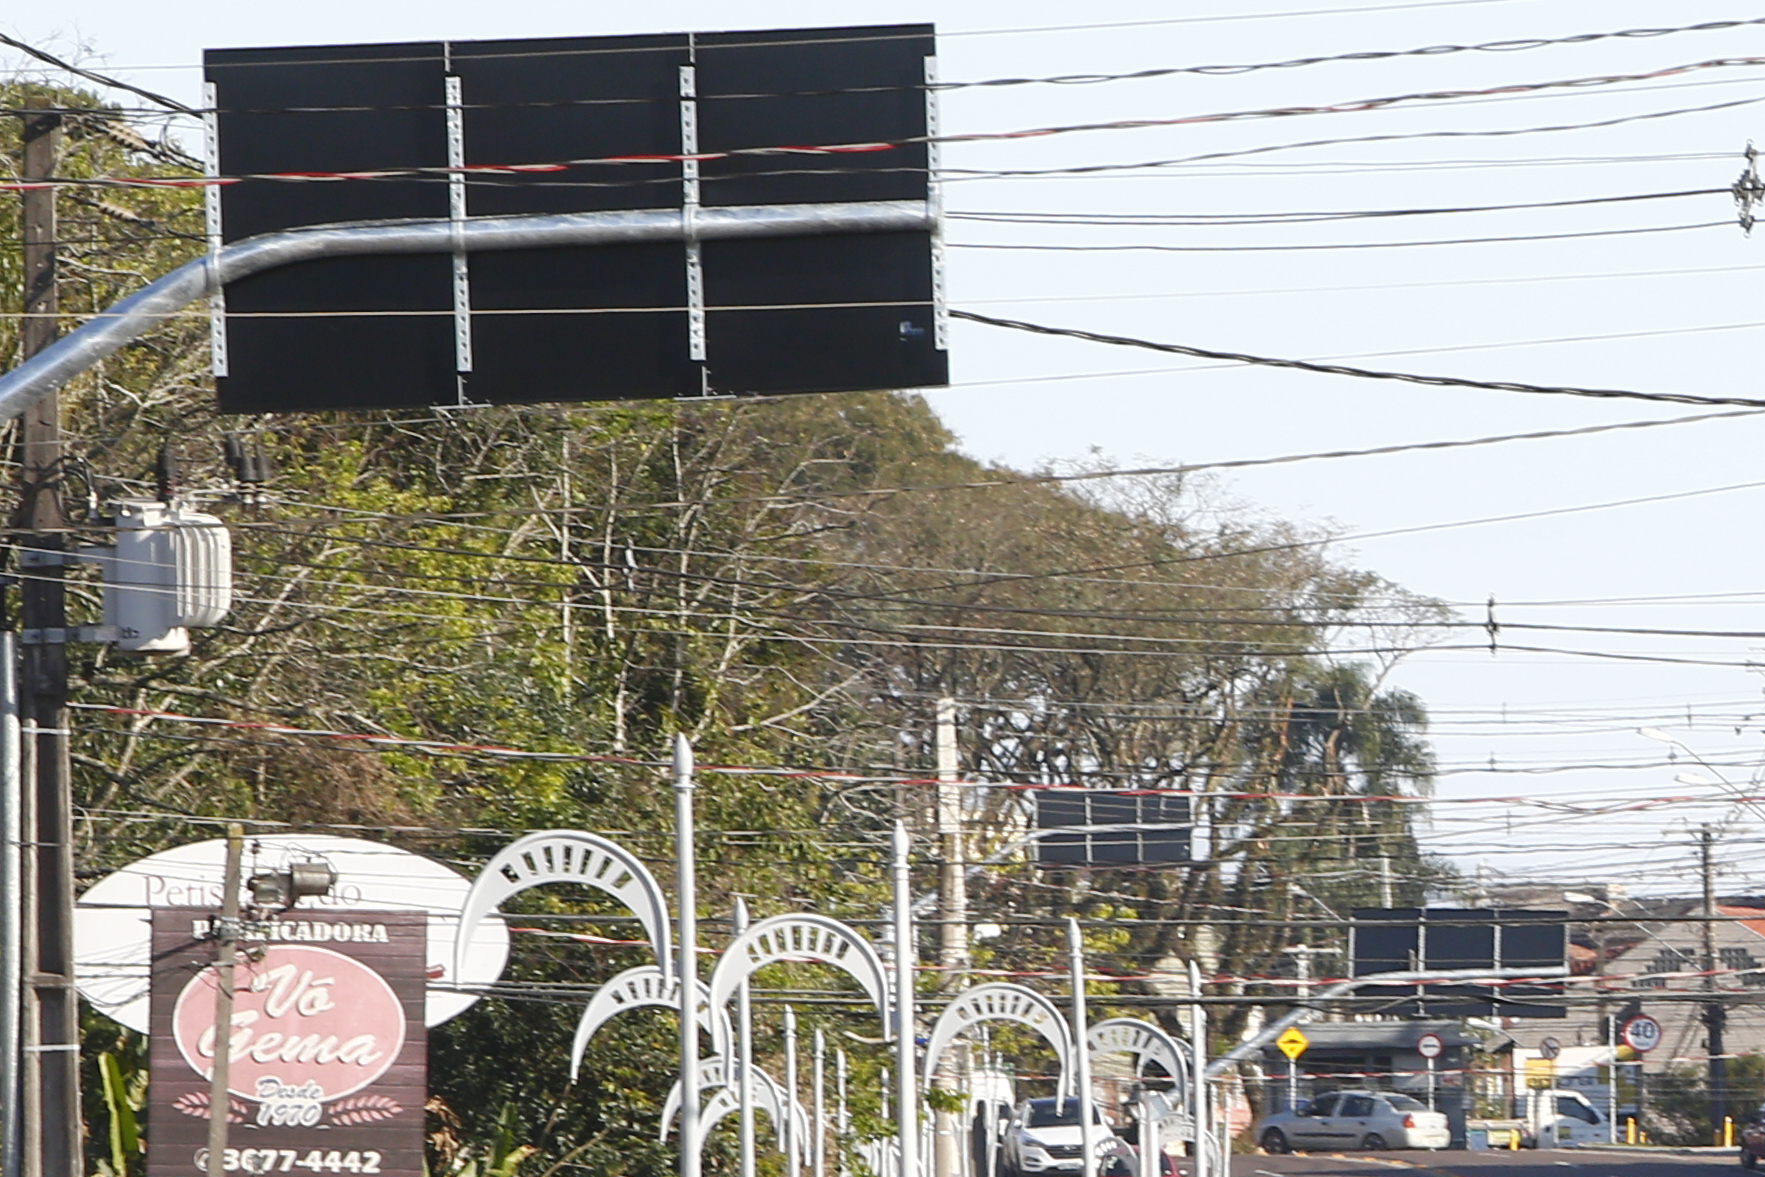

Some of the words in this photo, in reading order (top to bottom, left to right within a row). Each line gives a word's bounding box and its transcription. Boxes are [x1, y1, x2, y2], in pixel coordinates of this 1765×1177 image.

[1631, 1021, 1655, 1039] 40
[256, 1076, 323, 1101] Desde
[256, 1100, 323, 1127] 1970
